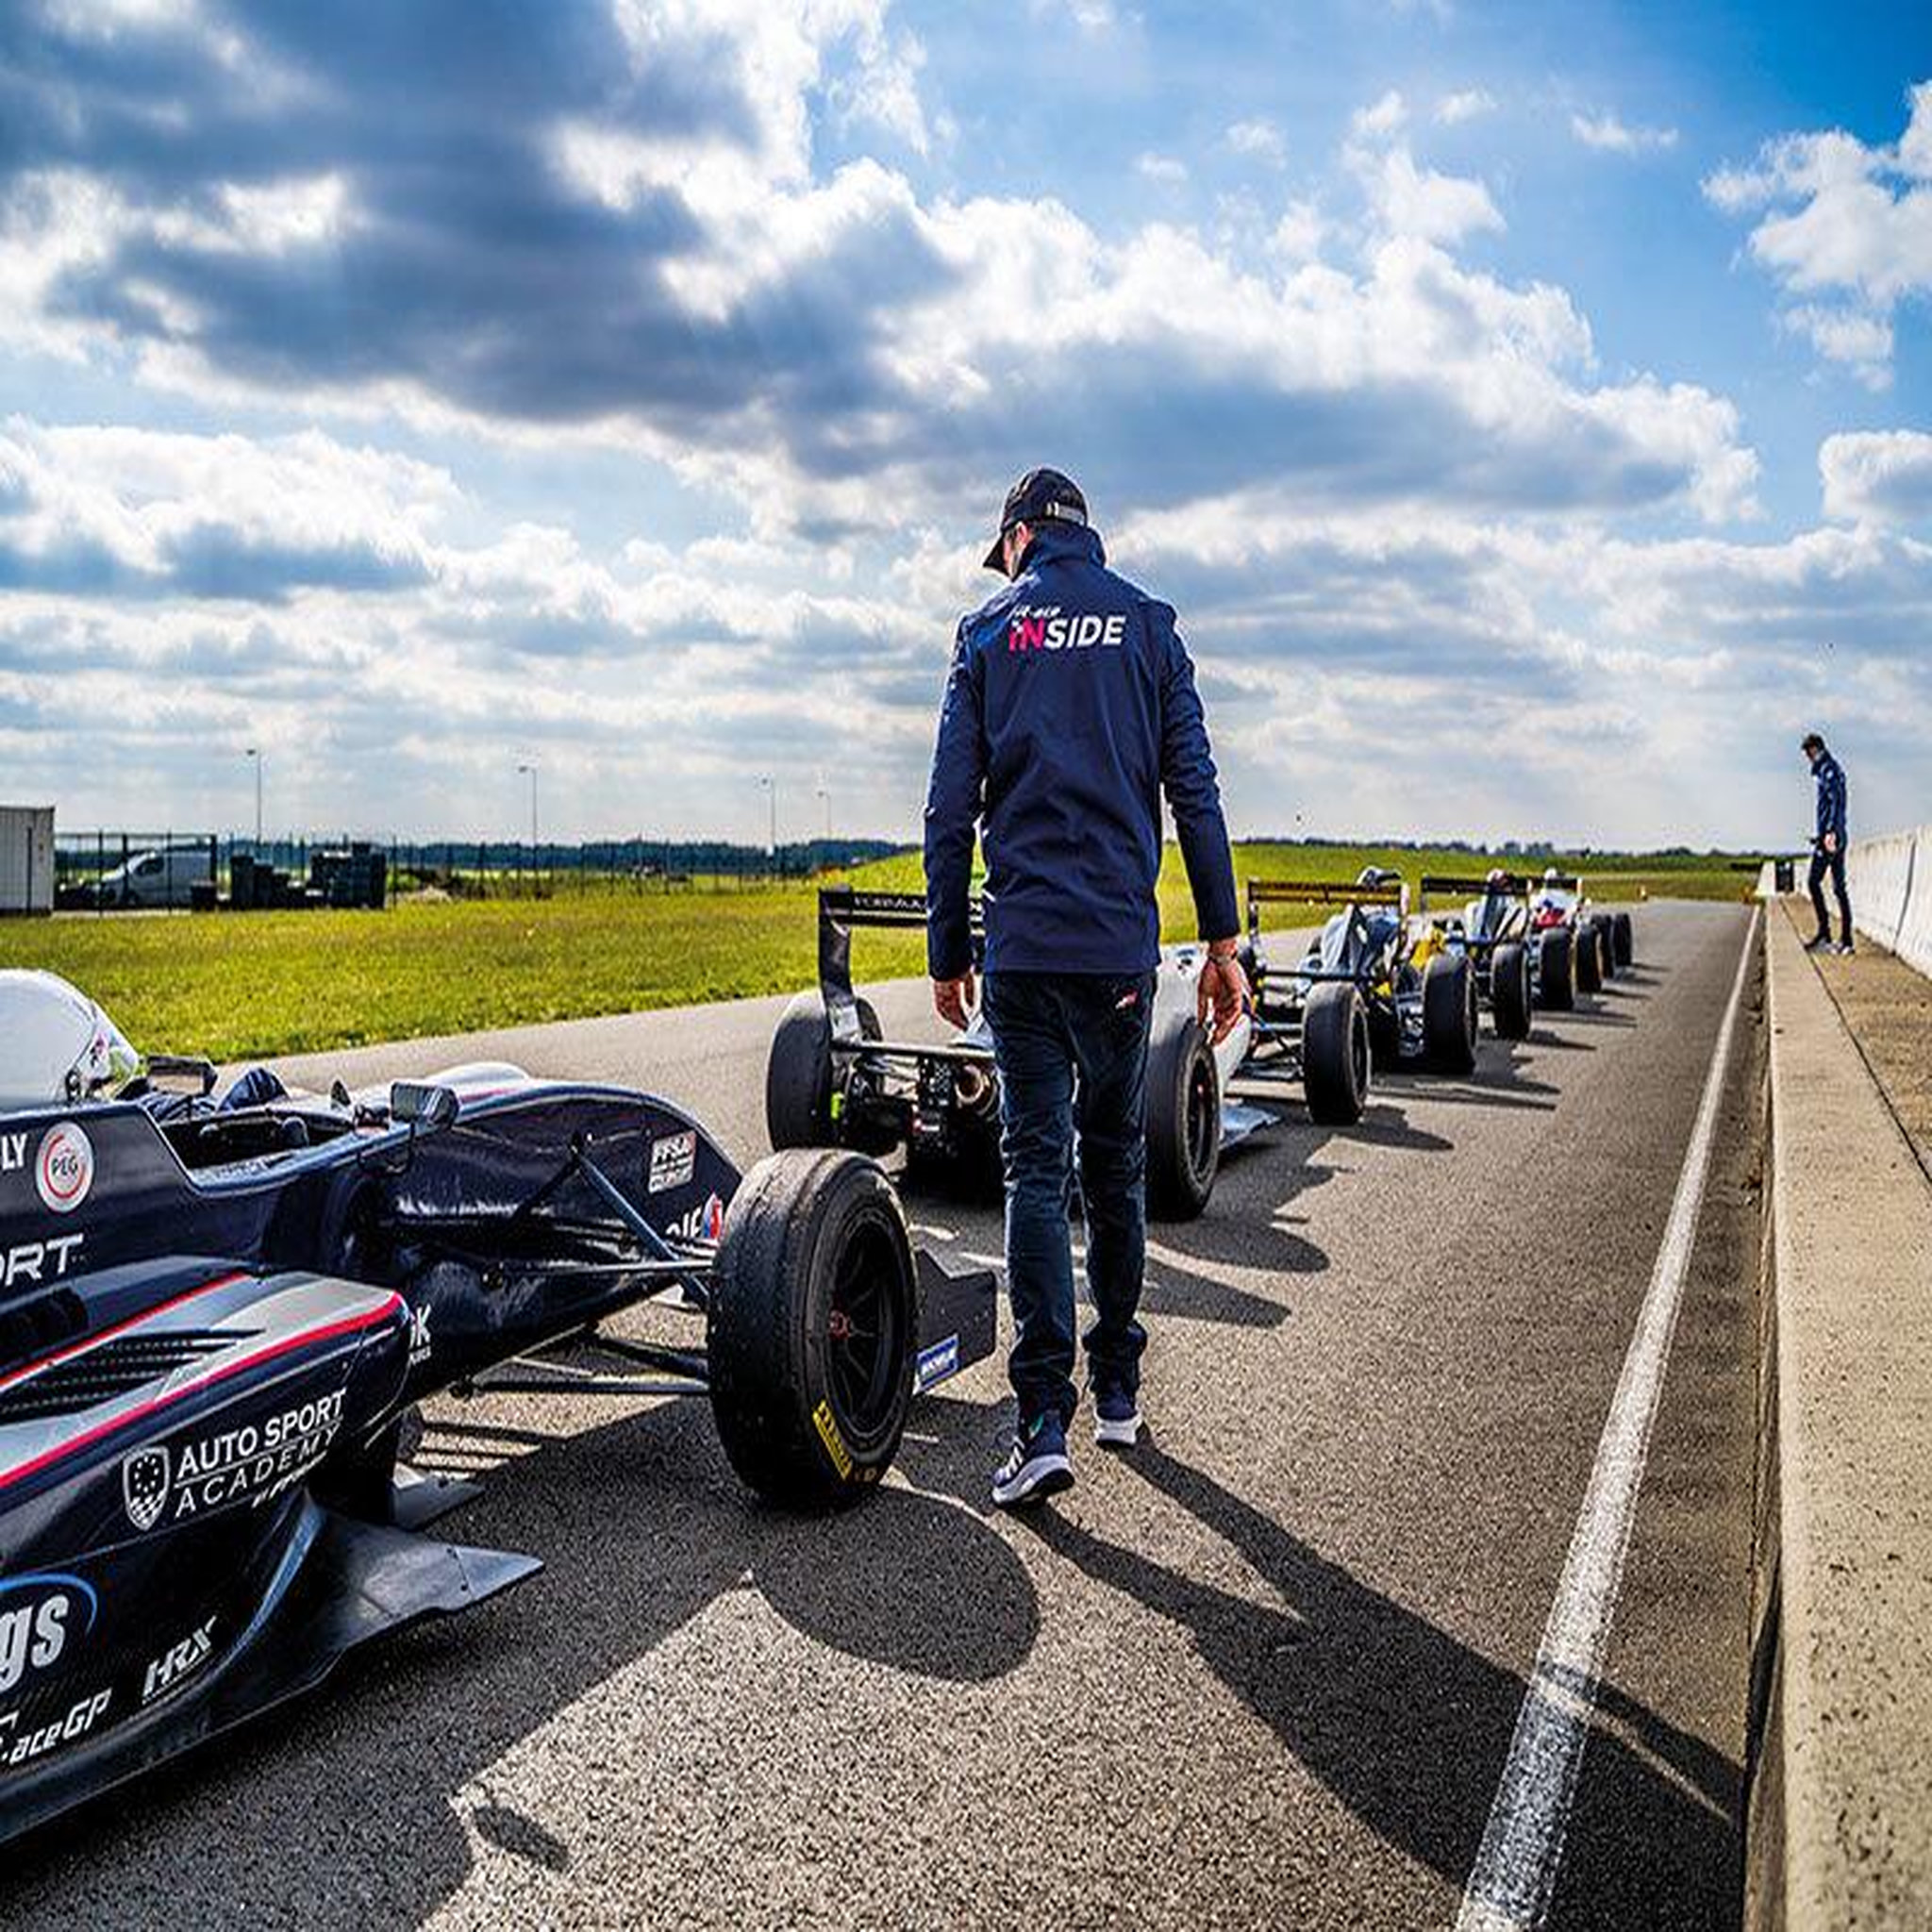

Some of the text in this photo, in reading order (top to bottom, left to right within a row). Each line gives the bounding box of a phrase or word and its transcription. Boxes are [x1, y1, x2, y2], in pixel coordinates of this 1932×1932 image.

[0, 1233, 84, 1286] RT
[174, 1422, 342, 1518] ACADEMY
[176, 1387, 347, 1479] AUTO SPORT
